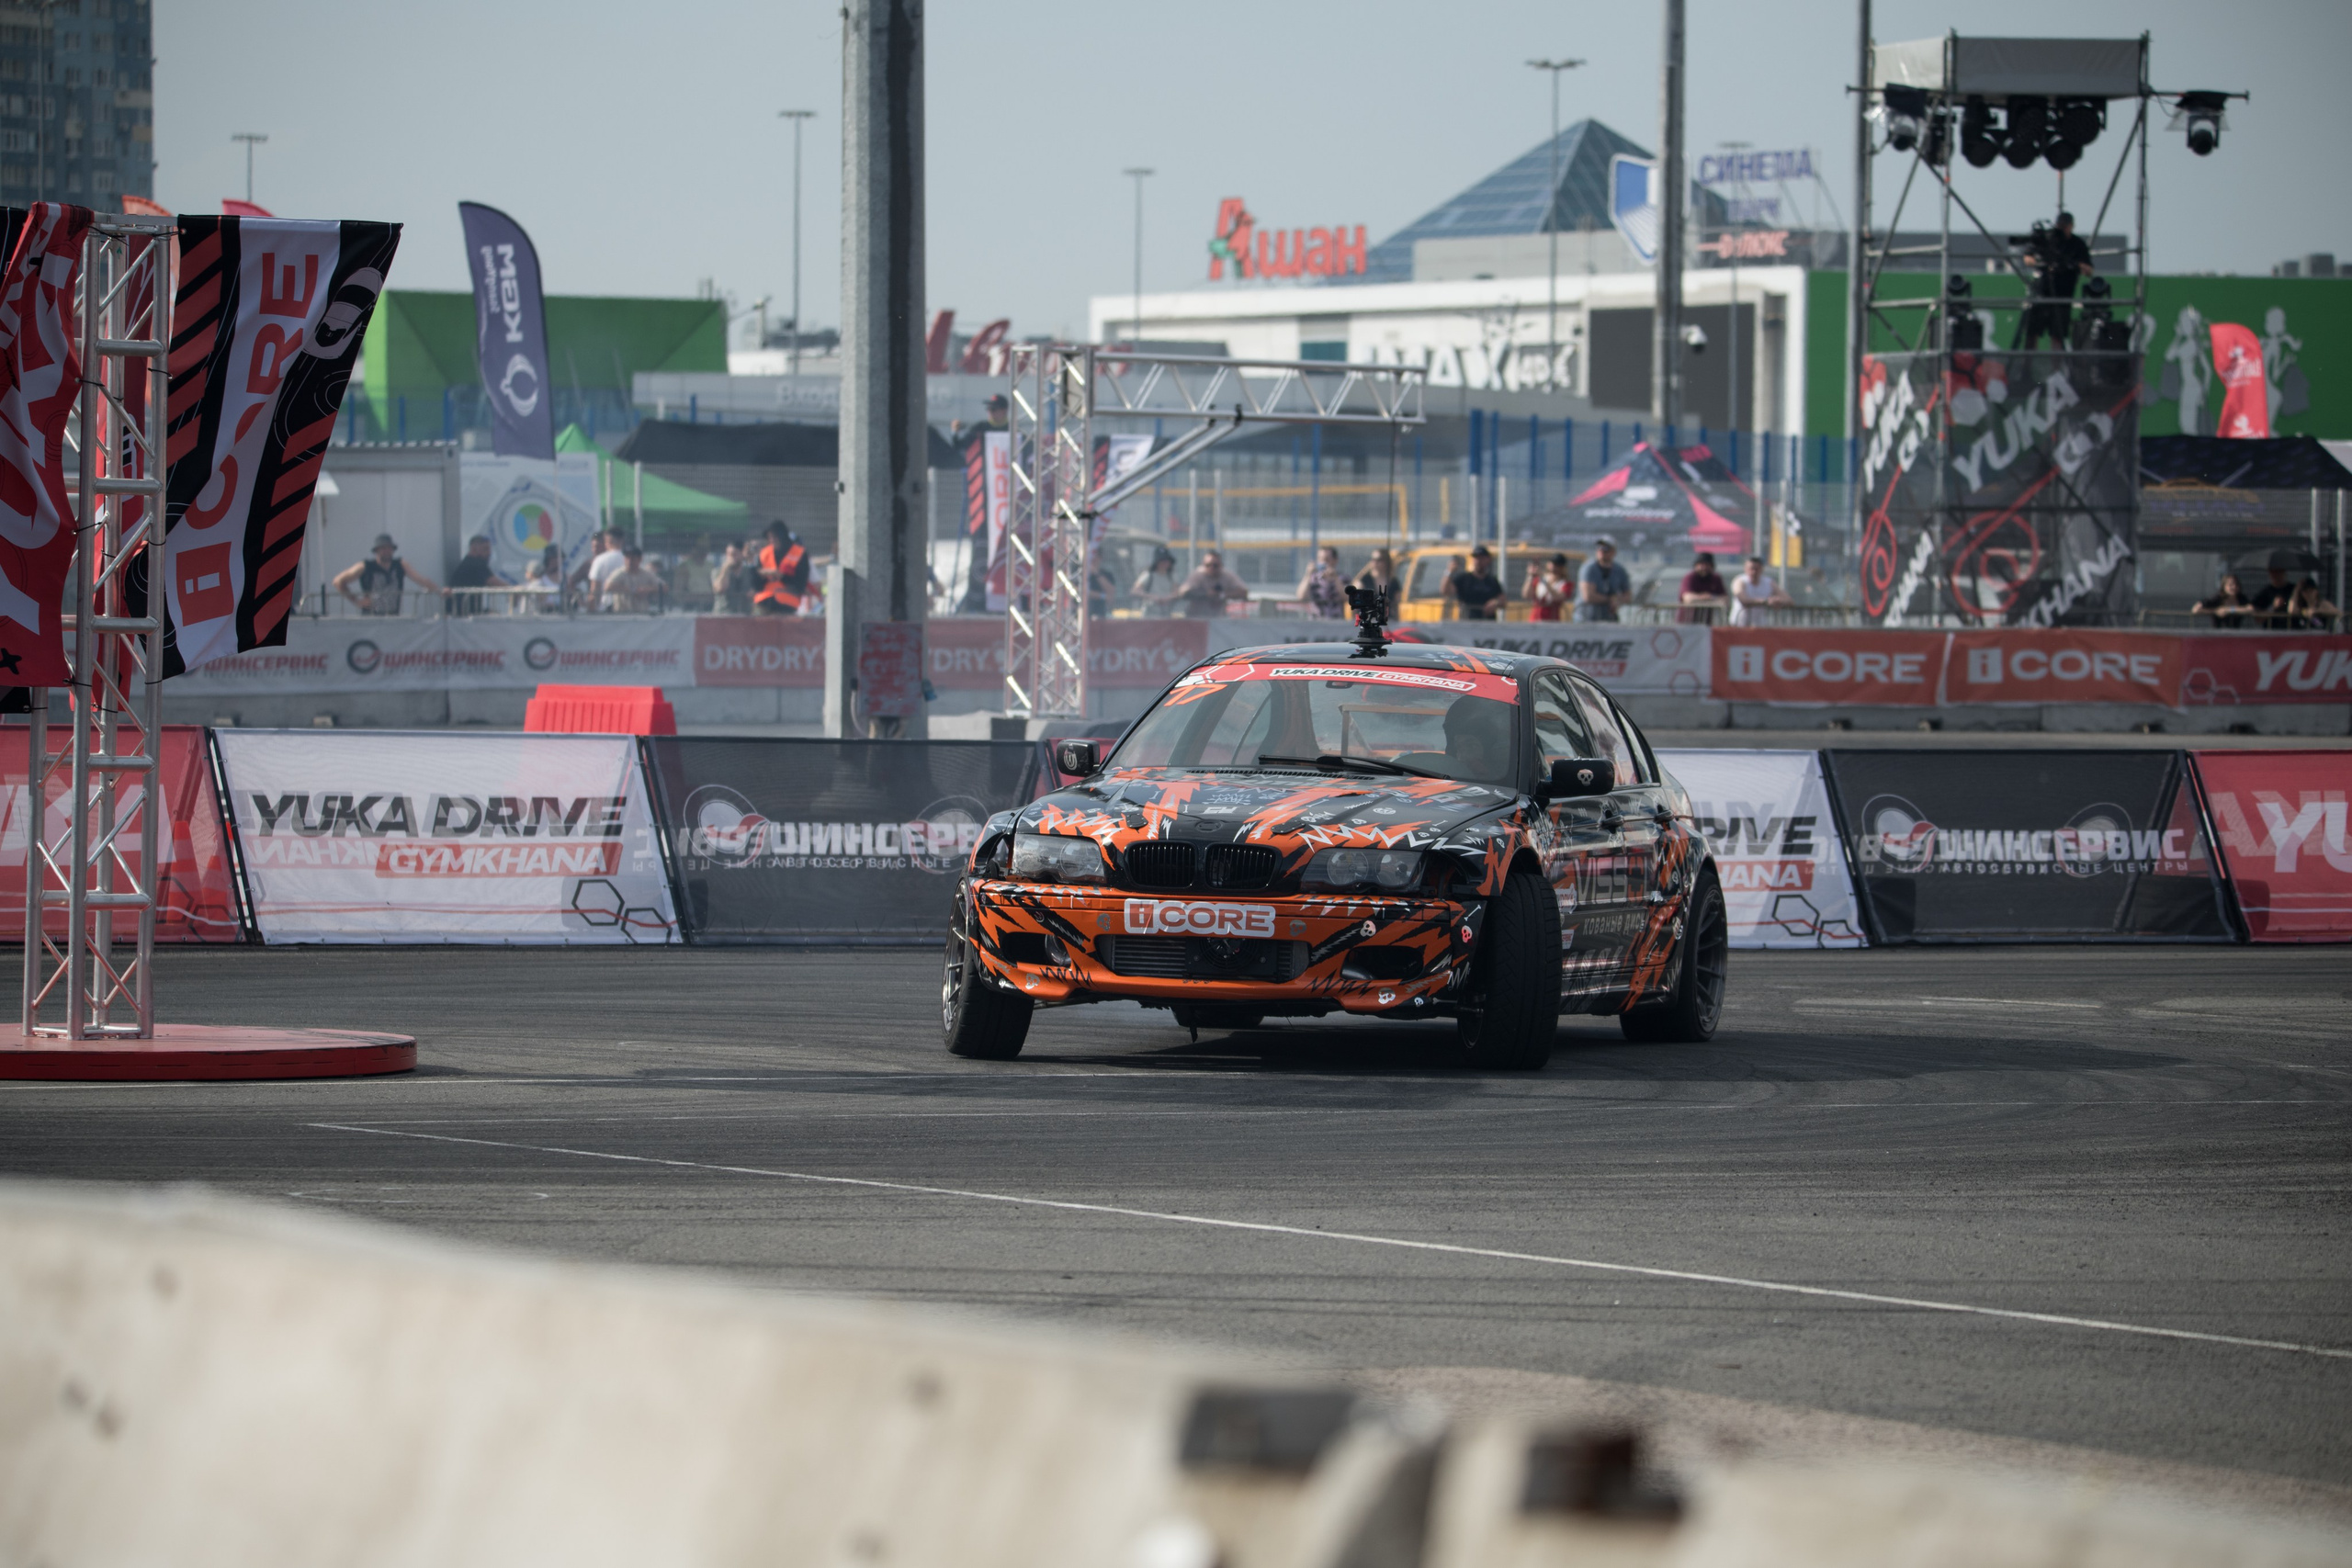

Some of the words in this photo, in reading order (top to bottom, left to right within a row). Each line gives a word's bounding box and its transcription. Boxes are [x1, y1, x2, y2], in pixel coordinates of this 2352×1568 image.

[1320, 670, 1377, 678] DRIVE
[1381, 673, 1466, 689] GYMKHANA
[252, 795, 419, 838] YUKA
[433, 795, 628, 838] DRIVE
[1692, 816, 1817, 855] RIVE
[389, 846, 608, 874] GYMKHANA
